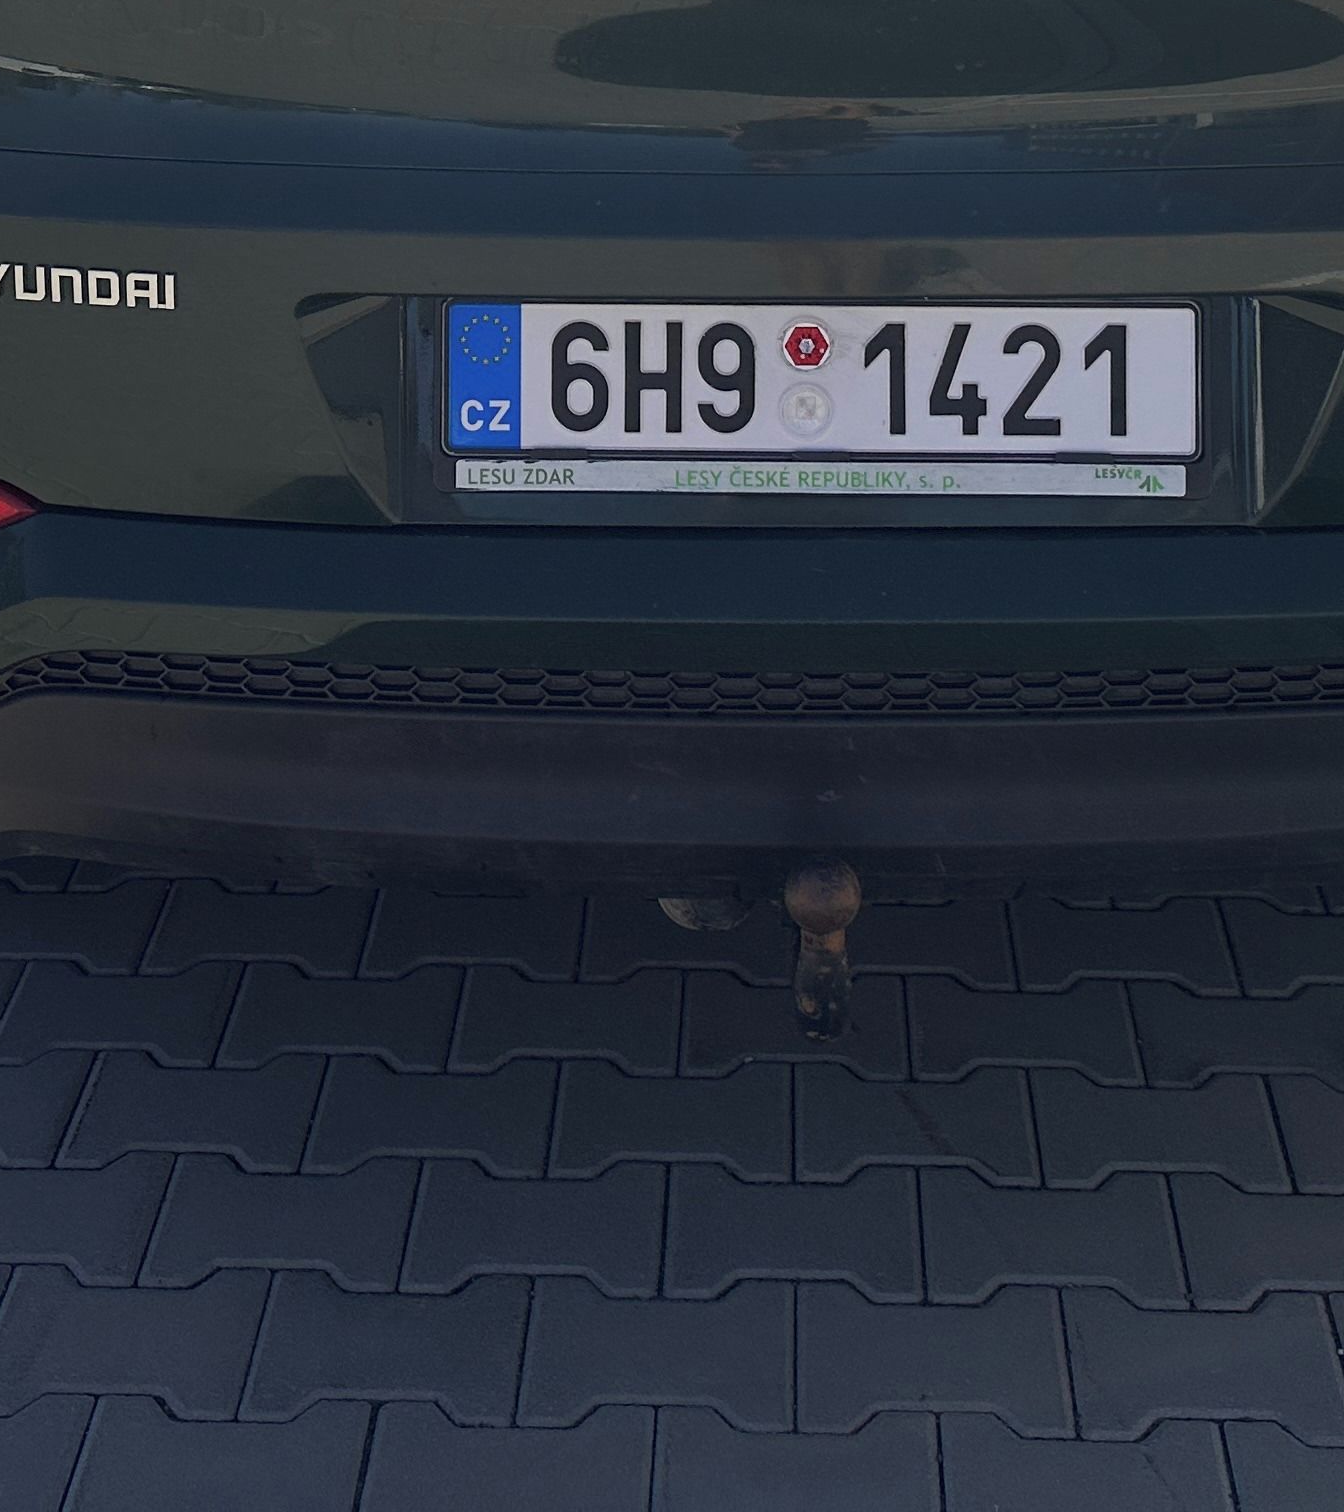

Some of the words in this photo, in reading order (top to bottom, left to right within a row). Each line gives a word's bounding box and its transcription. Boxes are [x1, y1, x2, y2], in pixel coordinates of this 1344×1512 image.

[550, 321, 756, 433] 6H9
[863, 323, 1128, 437] 1421
[460, 399, 511, 432] CZ
[467, 468, 516, 485] LESU
[523, 468, 575, 486] ZDAR
[675, 469, 723, 488] LESY
[729, 466, 790, 488] ČESKÉ
[798, 470, 911, 491] REPUBLIKY,
[919, 474, 934, 489] s.
[943, 474, 962, 492] p.
